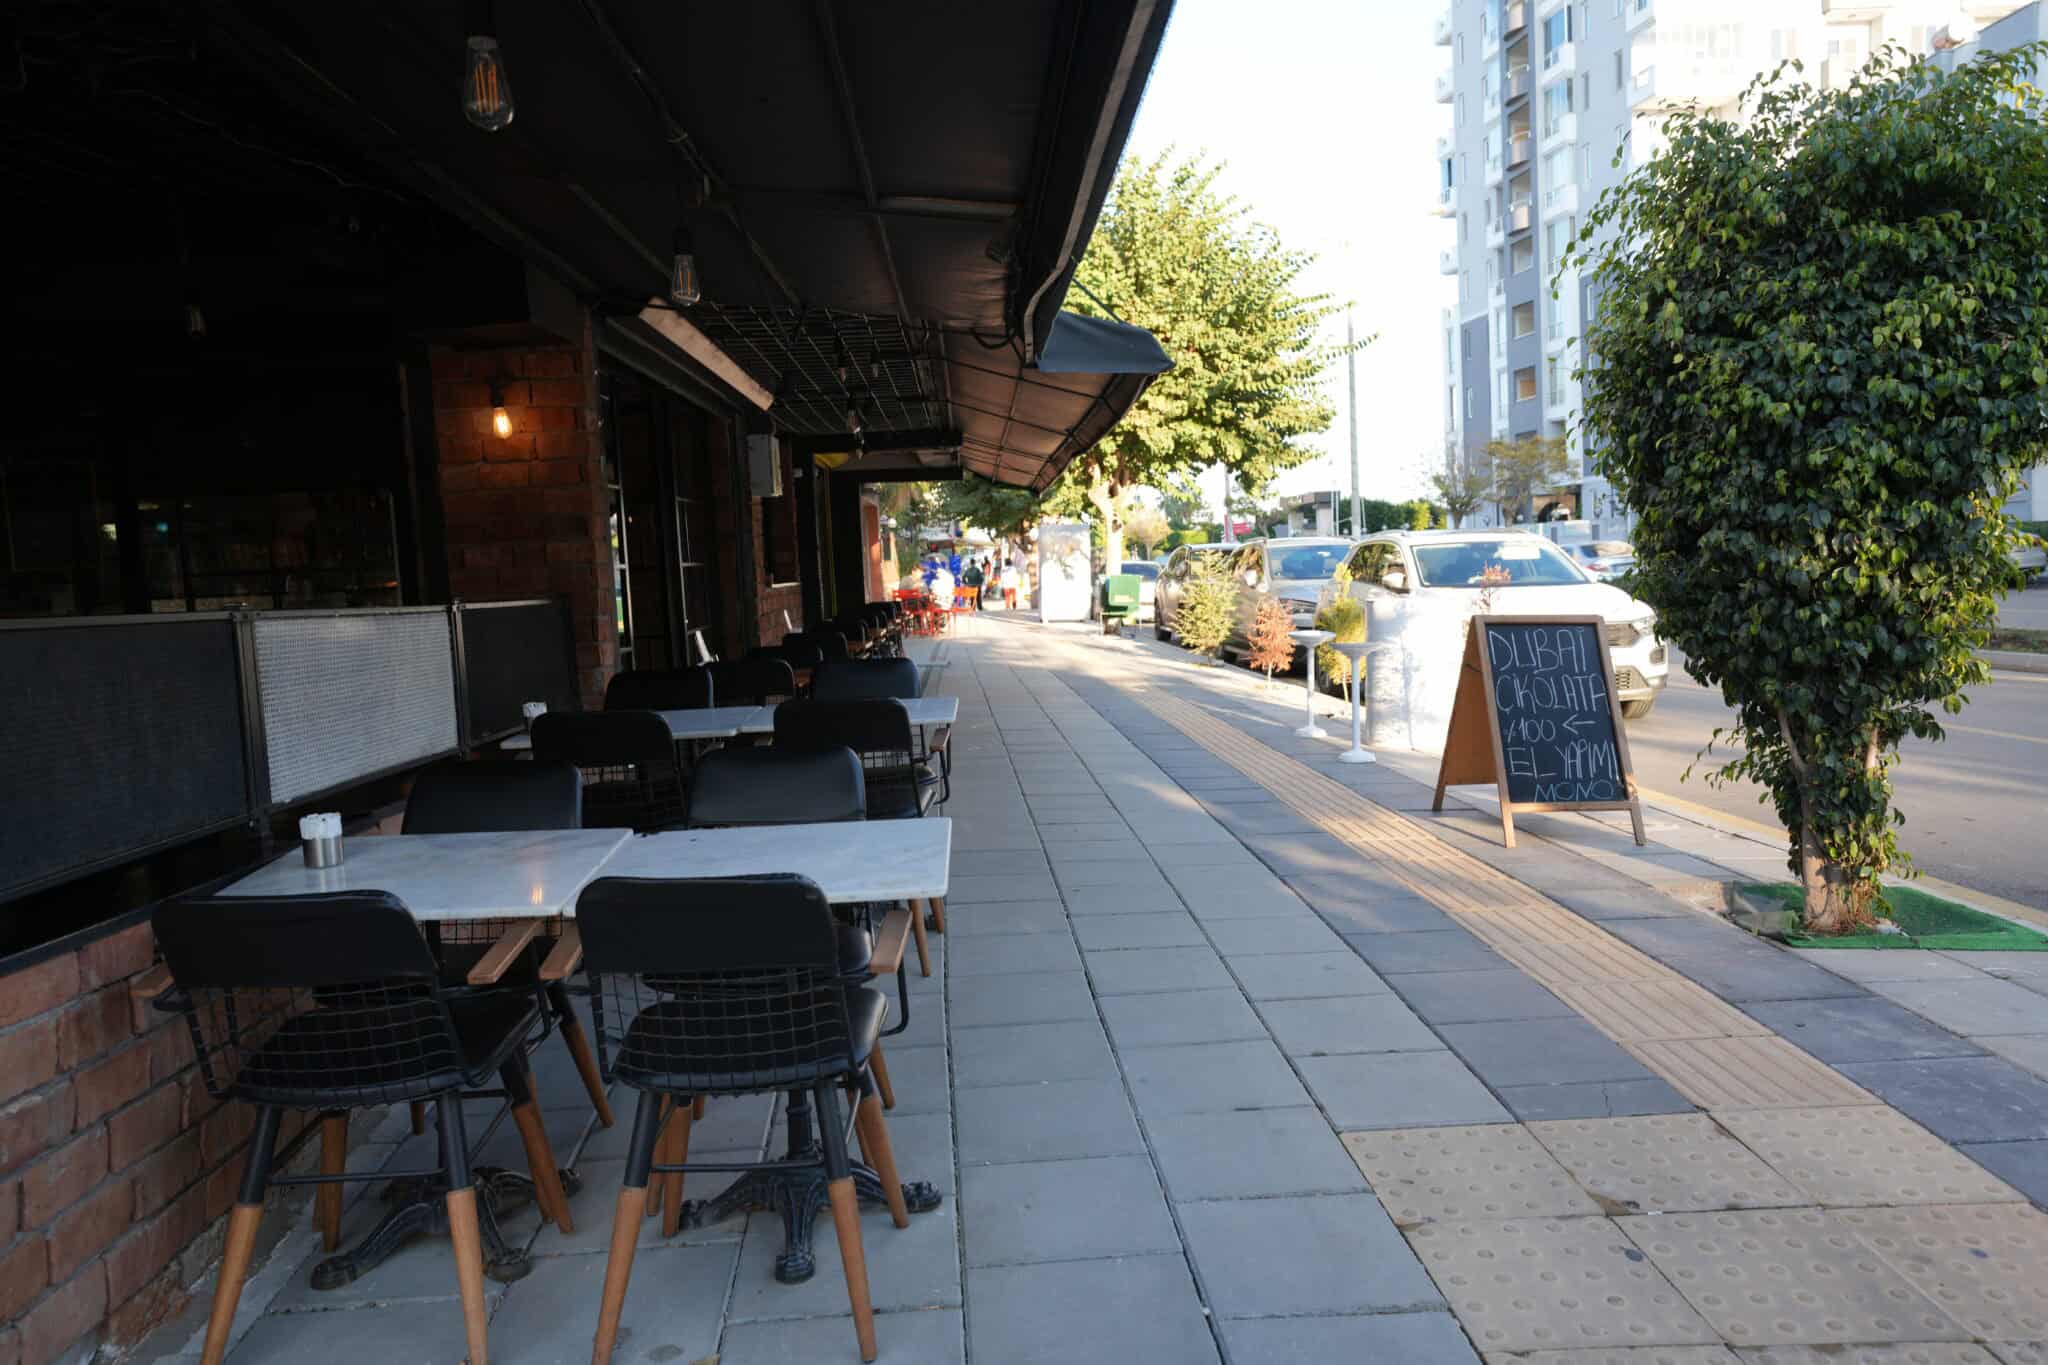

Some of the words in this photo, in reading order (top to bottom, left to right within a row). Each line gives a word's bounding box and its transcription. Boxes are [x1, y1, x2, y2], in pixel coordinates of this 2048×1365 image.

[1506, 745, 1558, 779] EL
[1554, 738, 1620, 781] YAPIMI
[1534, 778, 1614, 802] MONO
